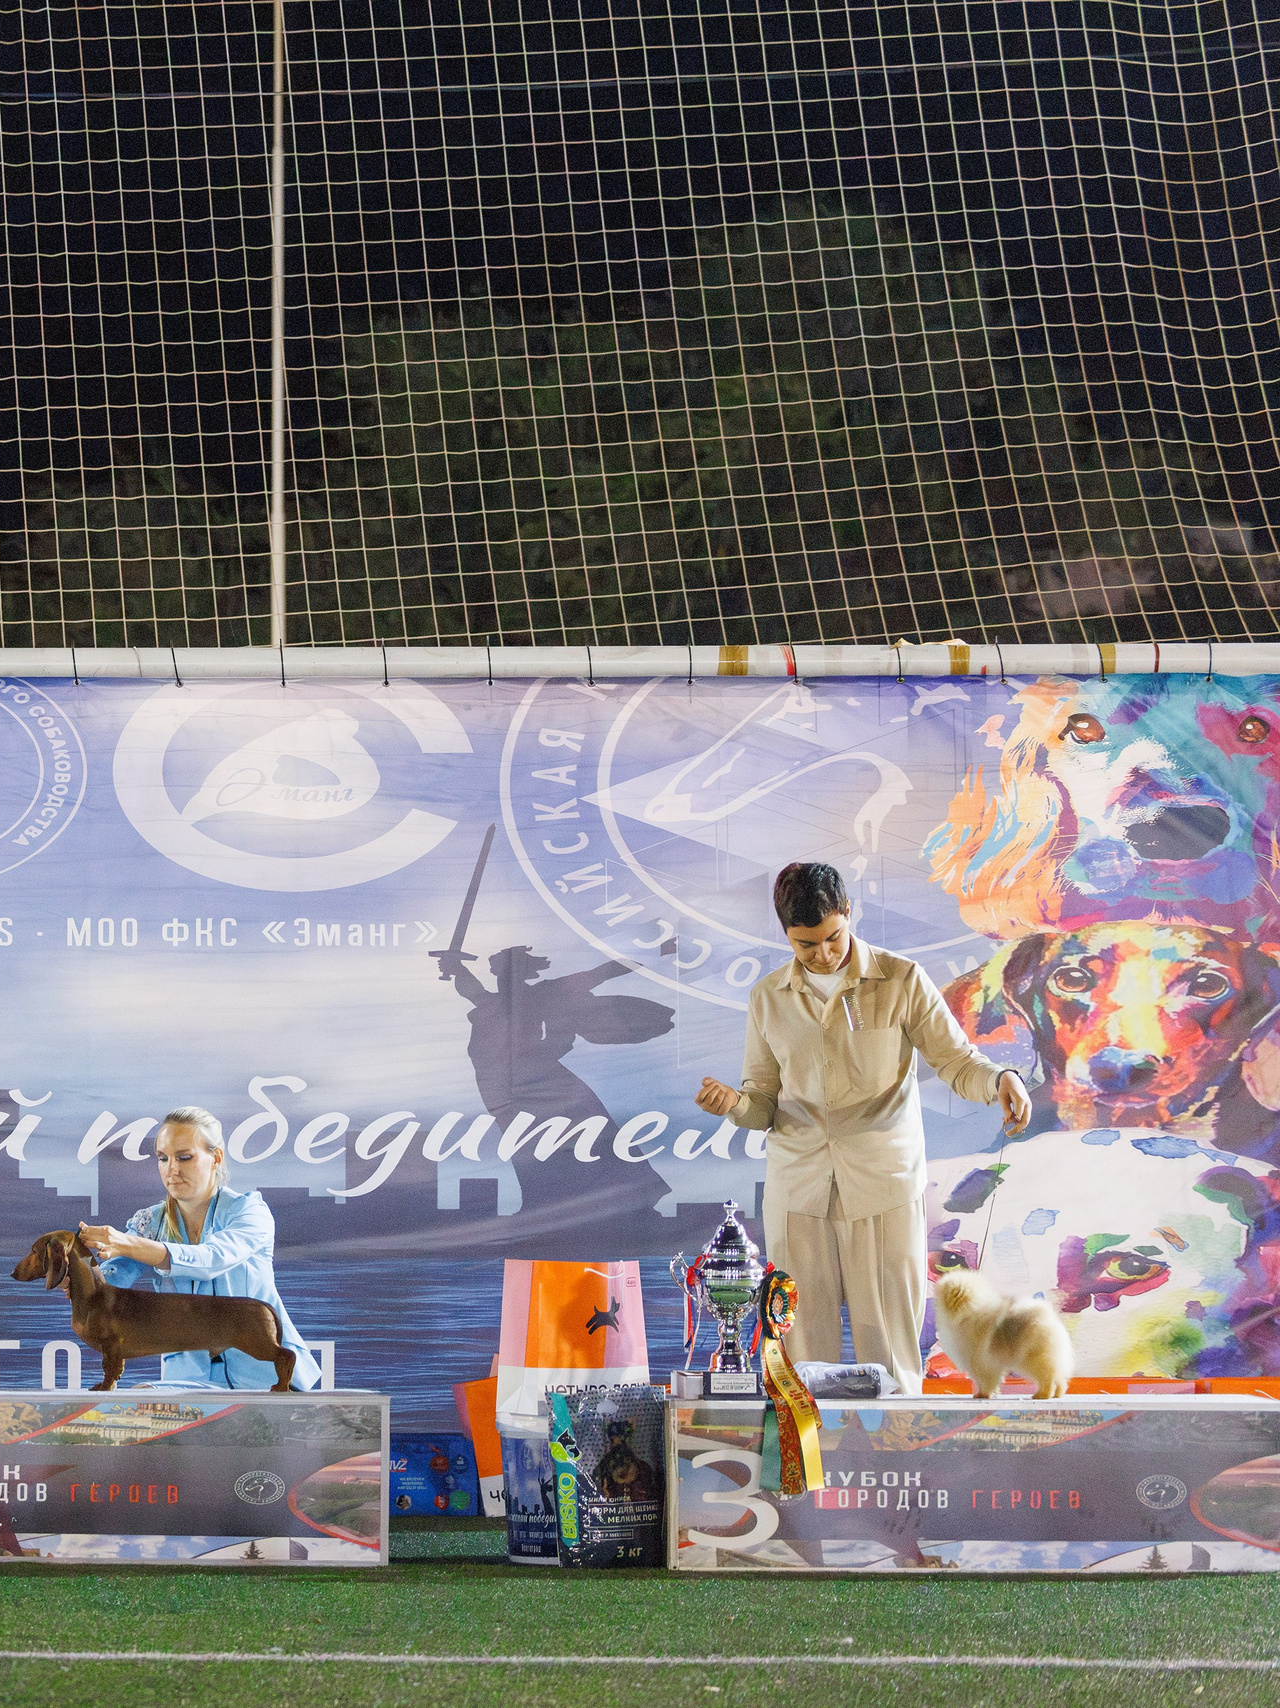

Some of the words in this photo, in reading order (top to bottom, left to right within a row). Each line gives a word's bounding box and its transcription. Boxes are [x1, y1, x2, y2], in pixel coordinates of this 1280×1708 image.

[11, 705, 72, 846] СОБАКОВОДСТВА
[531, 727, 762, 988] ОССИЙСКАЯ
[66, 917, 138, 947] МОО
[260, 917, 439, 947] «Эманг»
[70, 1484, 179, 1504] ГЕРОЕВ
[558, 1472, 578, 1539] BISKO
[687, 1450, 780, 1550] 3
[818, 1488, 950, 1511] ГОРОДОВ
[971, 1489, 1081, 1510] ГЕРОЕВ
[607, 1515, 641, 1524] МЕЛКИХ
[616, 1546, 624, 1558] 3
